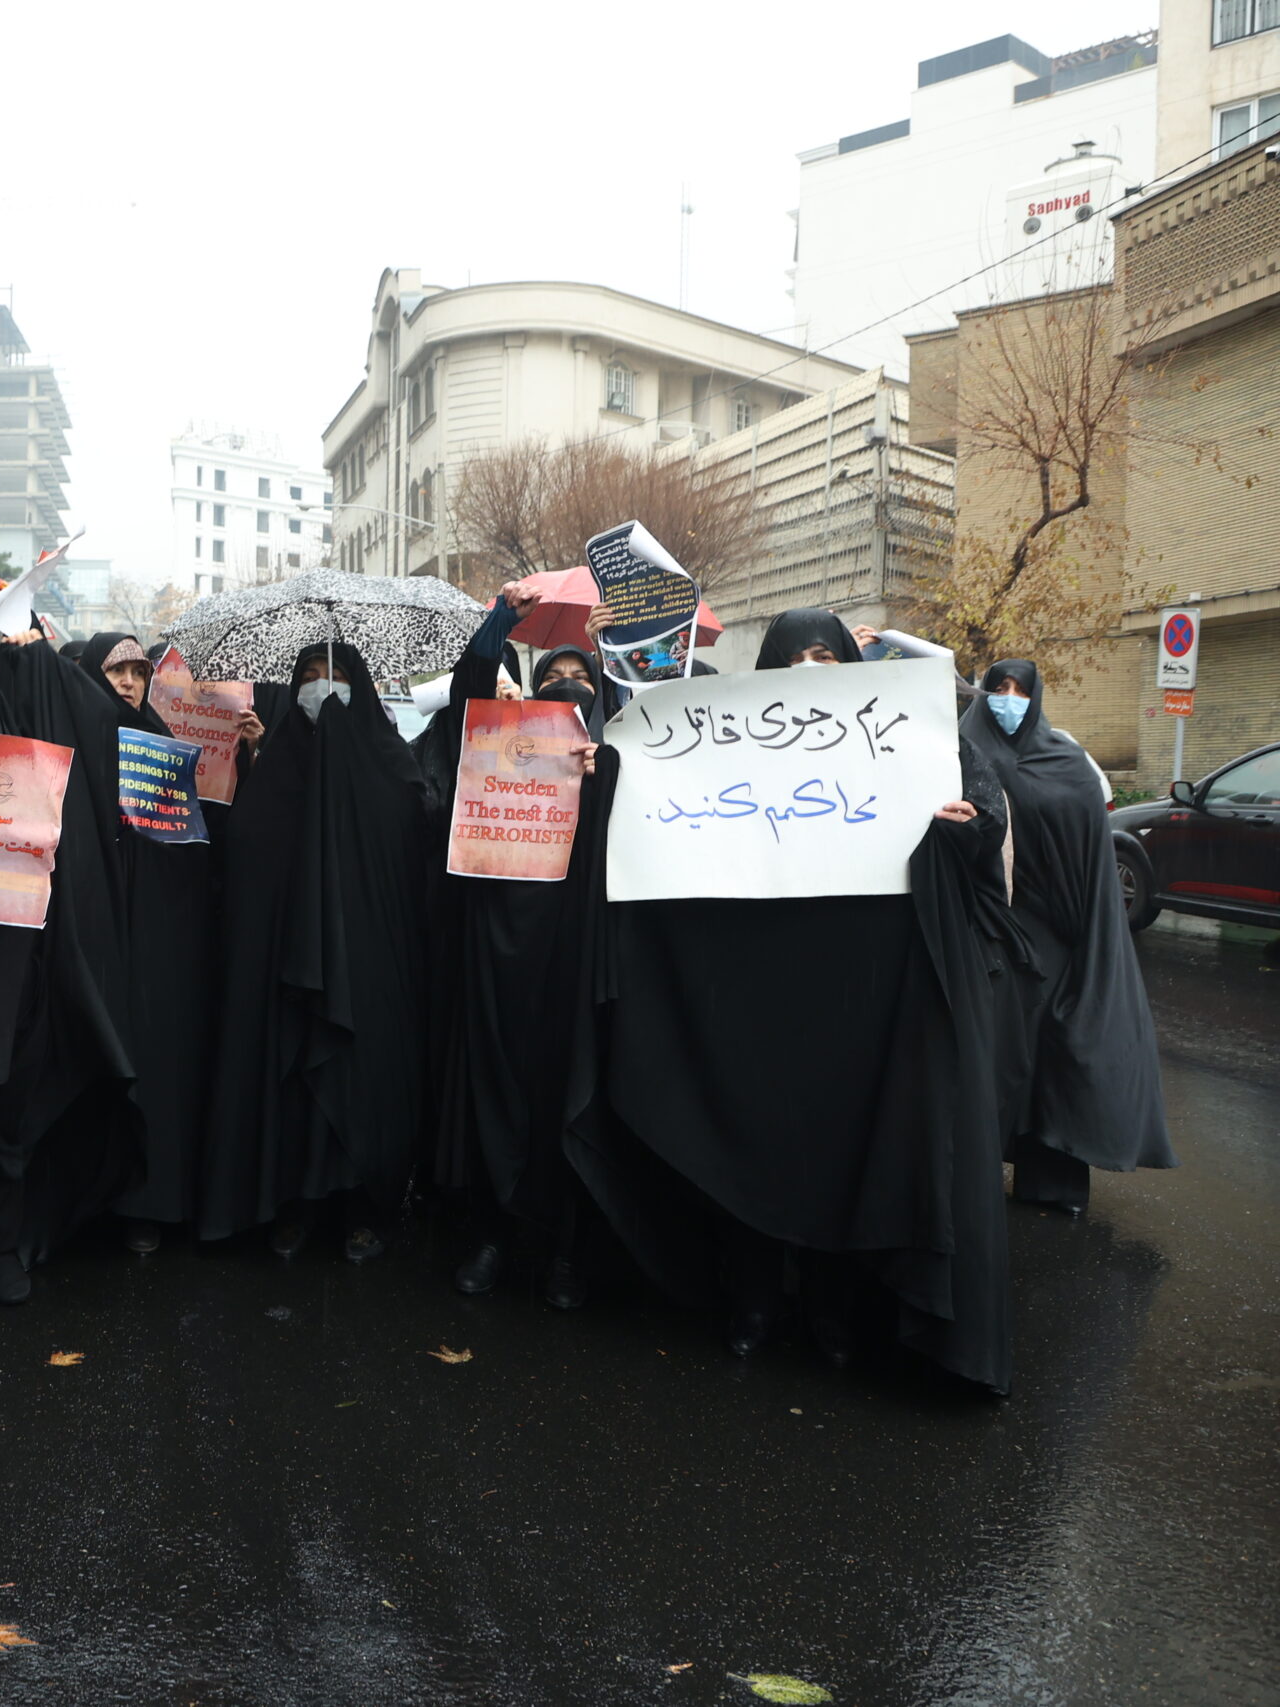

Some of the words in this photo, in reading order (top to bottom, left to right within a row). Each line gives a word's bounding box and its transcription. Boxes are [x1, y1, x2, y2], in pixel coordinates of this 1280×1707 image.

[605, 581, 627, 593] What
[629, 577, 646, 586] was
[648, 572, 661, 581] the
[607, 592, 638, 605] arakat
[674, 581, 693, 591] who
[614, 587, 628, 597] the
[630, 579, 664, 592] terrorist
[609, 599, 647, 611] urdered
[639, 604, 657, 614] and
[661, 597, 695, 610] children
[171, 697, 234, 721] Sweden
[640, 704, 673, 748] را
[641, 705, 742, 760] قاتل
[745, 701, 848, 752] رجوی
[855, 696, 909, 760] مریم
[127, 744, 169, 763] REFUSED
[170, 754, 184, 766] TO
[163, 770, 177, 782] TO
[484, 775, 559, 798] Sweden
[119, 778, 188, 801] PIDERMOLYSIS
[121, 815, 151, 829] THEIR
[465, 800, 501, 819] The
[504, 804, 544, 822] nest
[545, 806, 574, 824] for
[456, 823, 575, 845] TERRORISTS
[5, 841, 45, 859] بهشت
